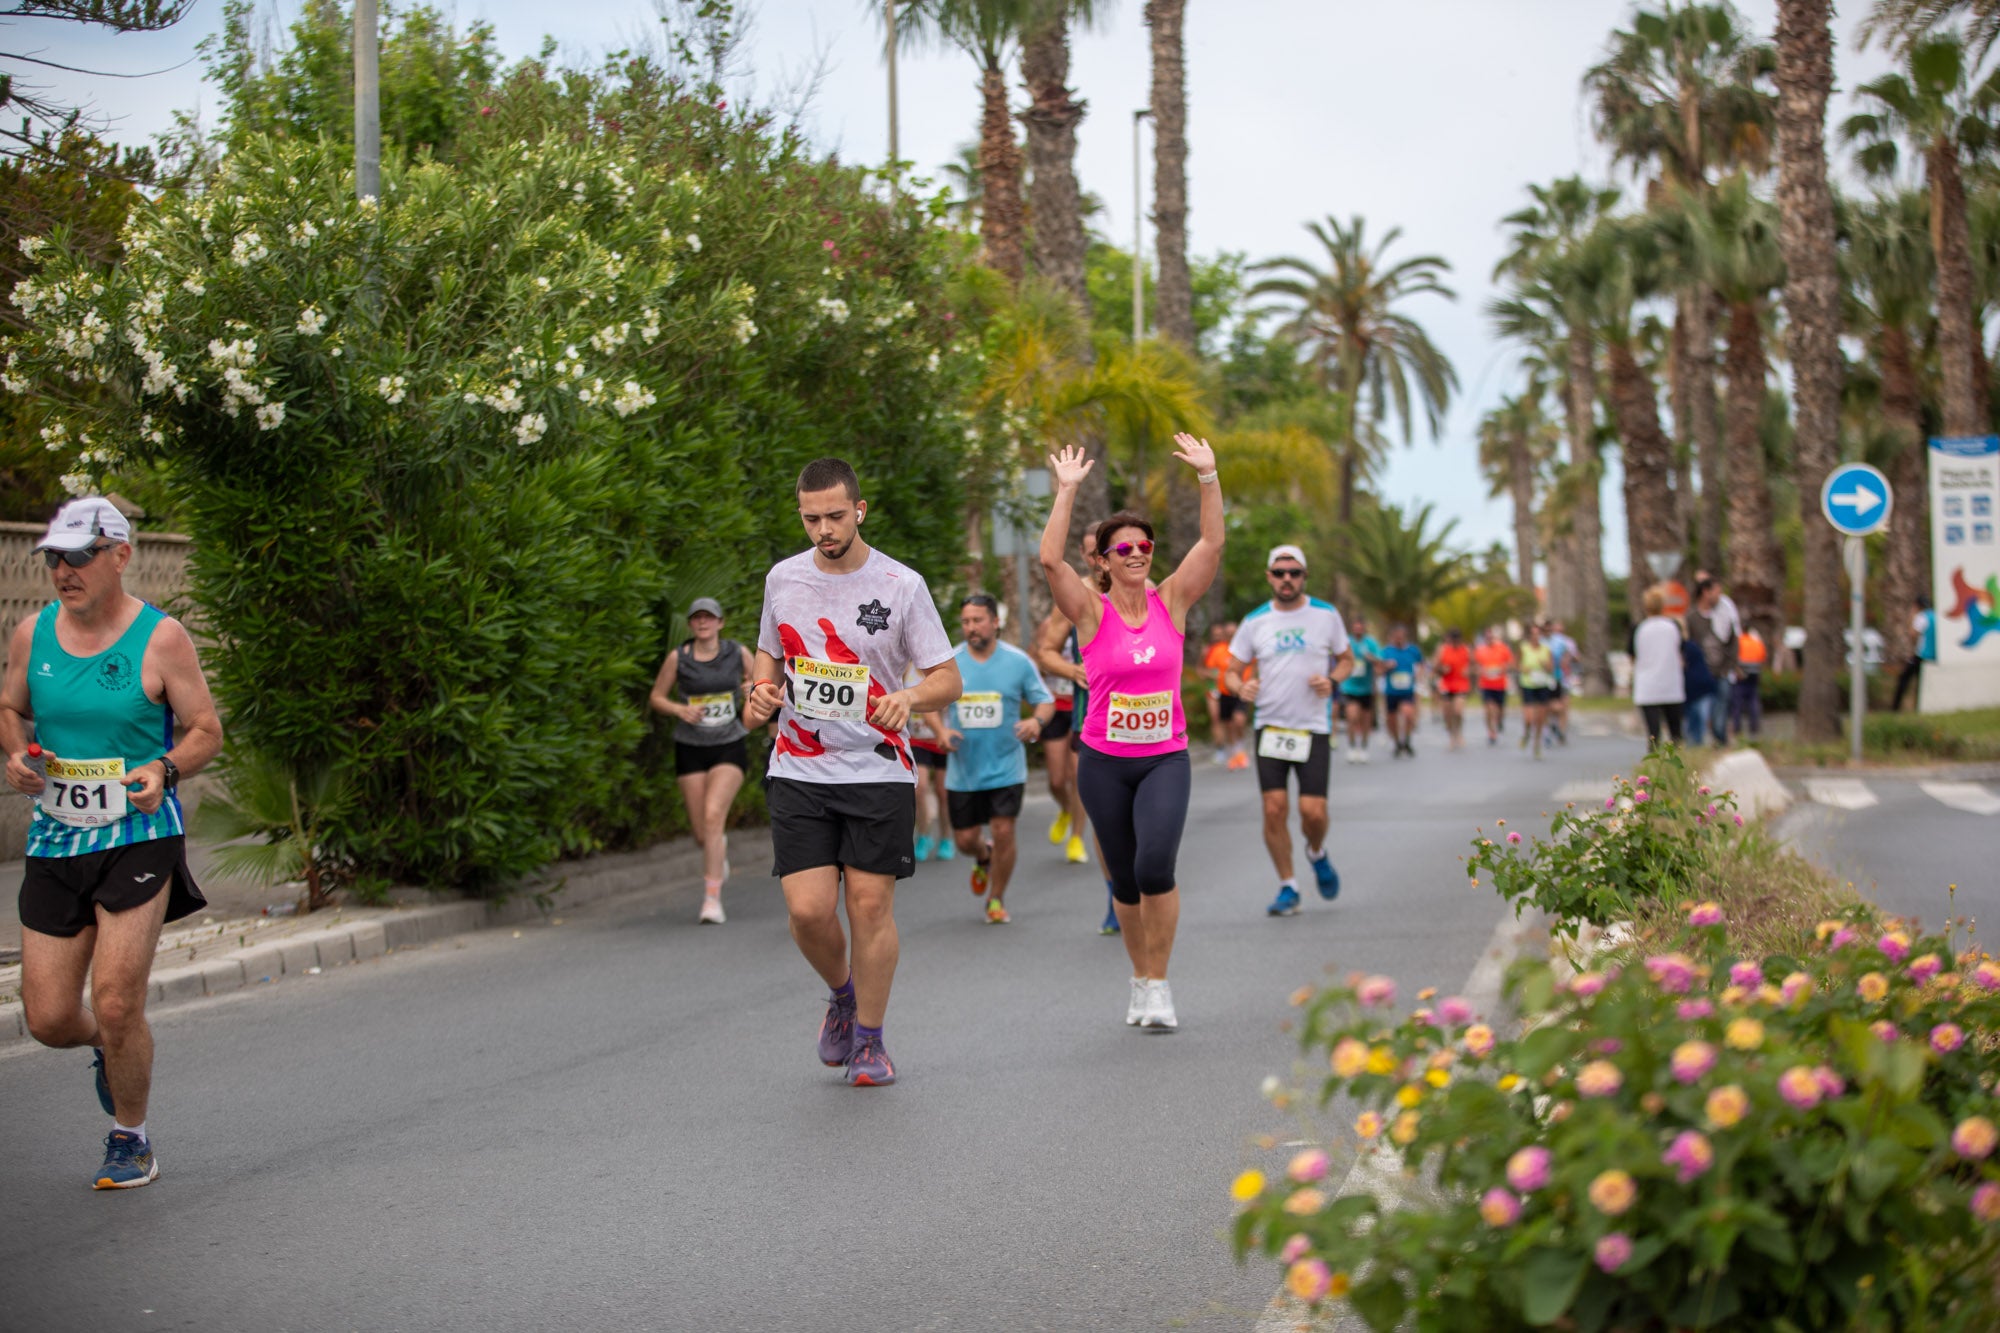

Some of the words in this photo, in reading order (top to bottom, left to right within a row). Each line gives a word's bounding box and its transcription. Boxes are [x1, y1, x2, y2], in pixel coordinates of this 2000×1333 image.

[805, 661, 815, 673] 38
[814, 666, 852, 678] FONDO
[803, 678, 855, 707] 790
[963, 705, 995, 719] 709
[1110, 709, 1169, 731] 2099
[1275, 736, 1296, 751] 76
[61, 767, 105, 777] FONDO
[53, 782, 107, 810] 761
